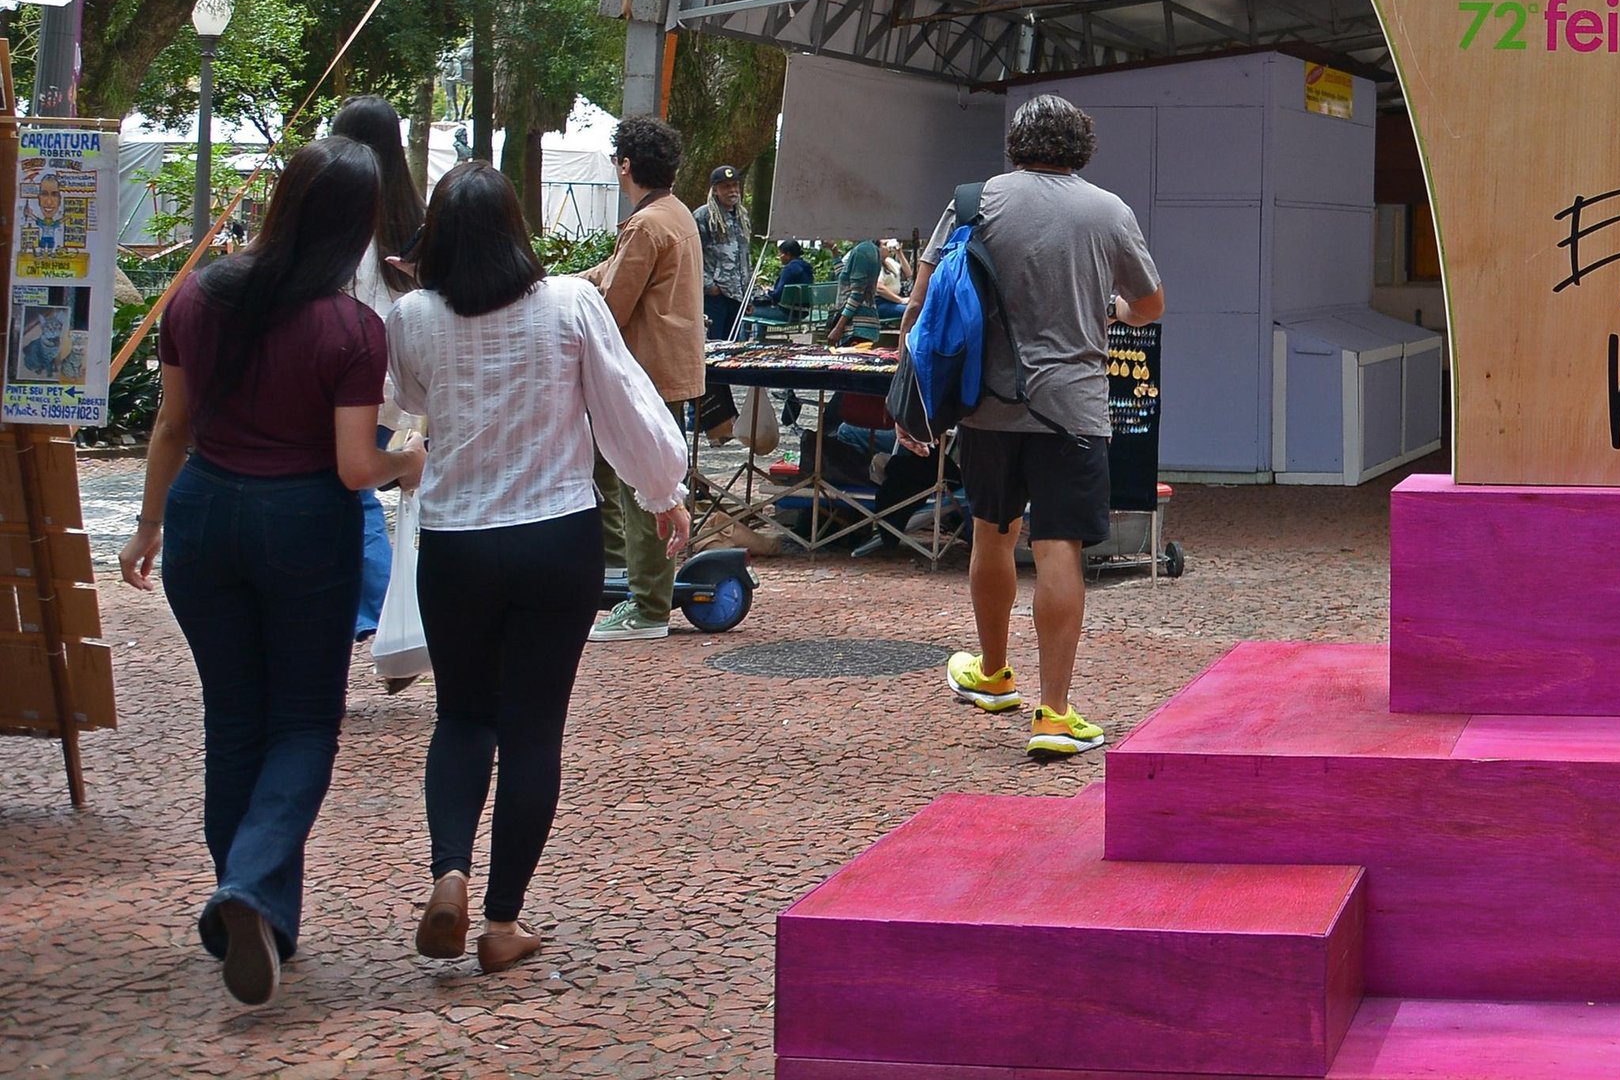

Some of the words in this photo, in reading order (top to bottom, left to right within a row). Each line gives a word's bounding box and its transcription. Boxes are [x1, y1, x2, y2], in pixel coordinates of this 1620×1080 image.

[20, 133, 101, 152] CARICATURA
[39, 148, 83, 157] ROBERTO
[6, 385, 28, 395] PINTE
[30, 386, 44, 395] SEU
[47, 387, 64, 396] PET
